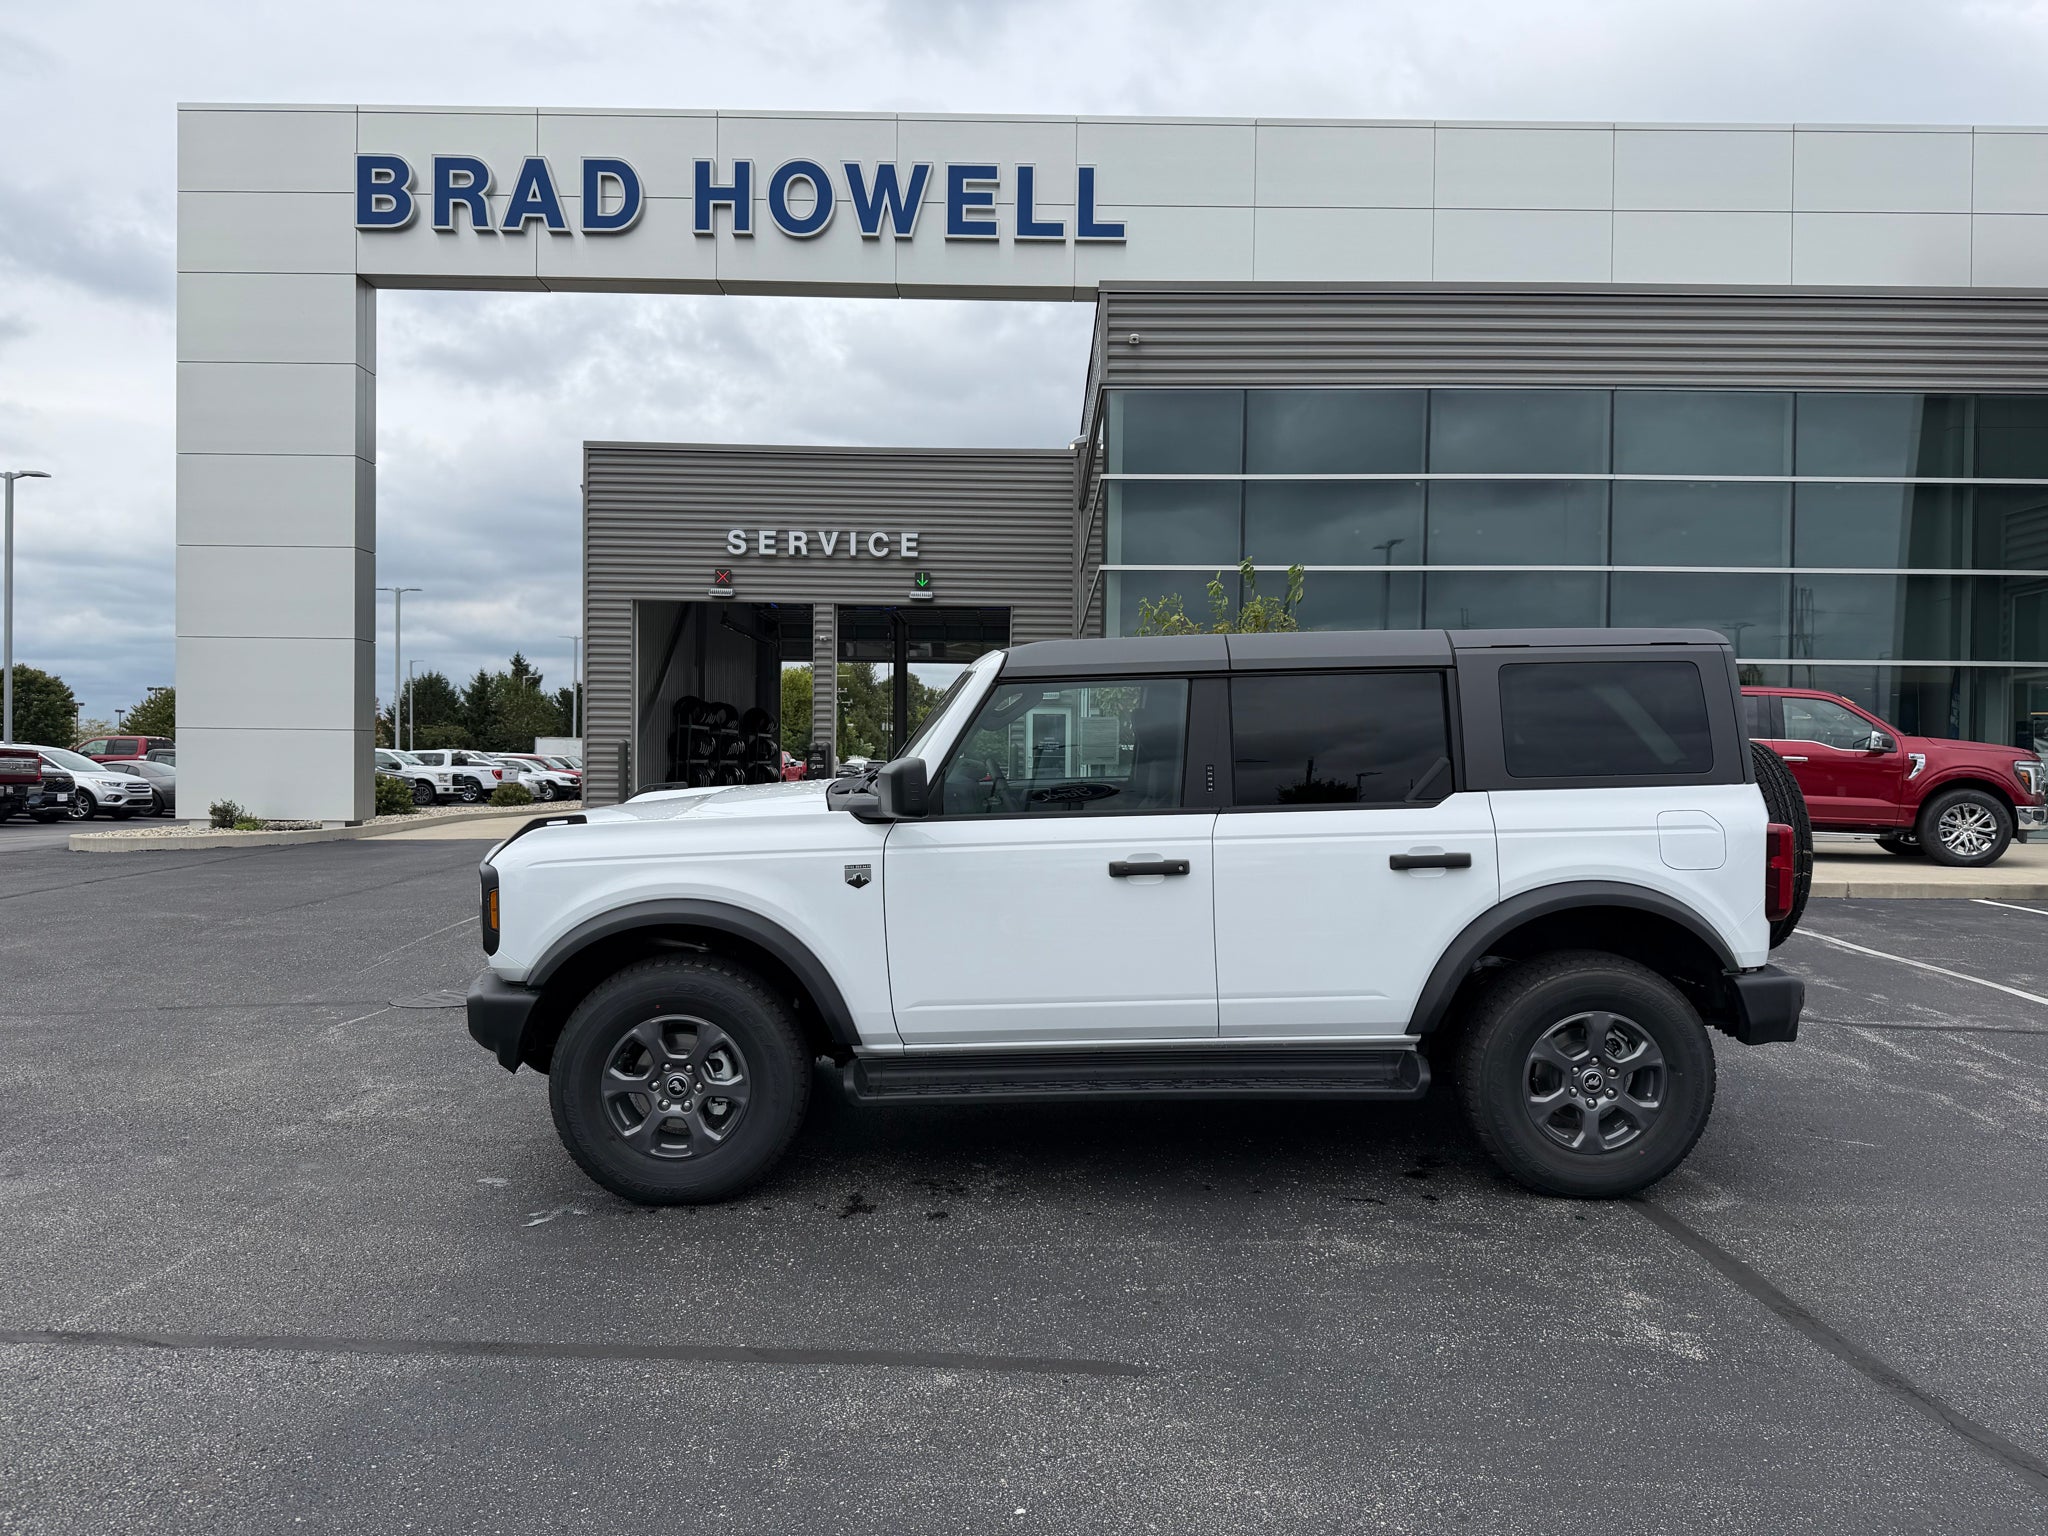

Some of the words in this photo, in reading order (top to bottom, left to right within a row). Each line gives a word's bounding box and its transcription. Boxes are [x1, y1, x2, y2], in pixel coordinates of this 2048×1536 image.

[354, 154, 645, 235] BRAD
[691, 158, 1127, 243] HOWELL
[727, 529, 920, 558] SERVICE
